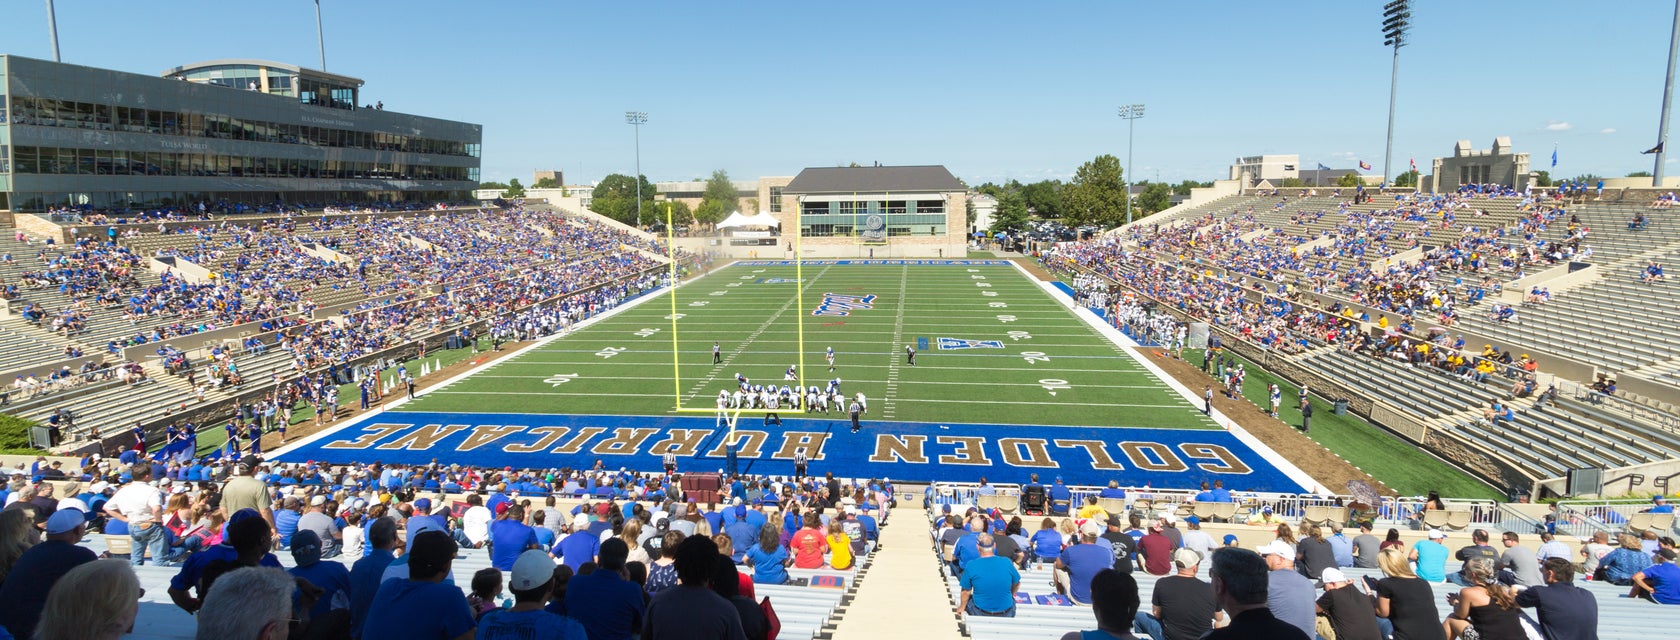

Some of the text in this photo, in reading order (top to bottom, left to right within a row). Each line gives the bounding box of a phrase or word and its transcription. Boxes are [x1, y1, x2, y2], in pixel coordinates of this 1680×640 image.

[183, 142, 208, 150] WORLD
[594, 346, 627, 358] 20
[1020, 351, 1050, 362] 20
[543, 372, 579, 384] 10
[1038, 378, 1072, 390] 10
[320, 422, 1255, 475] GOLDEN HURRICANE
